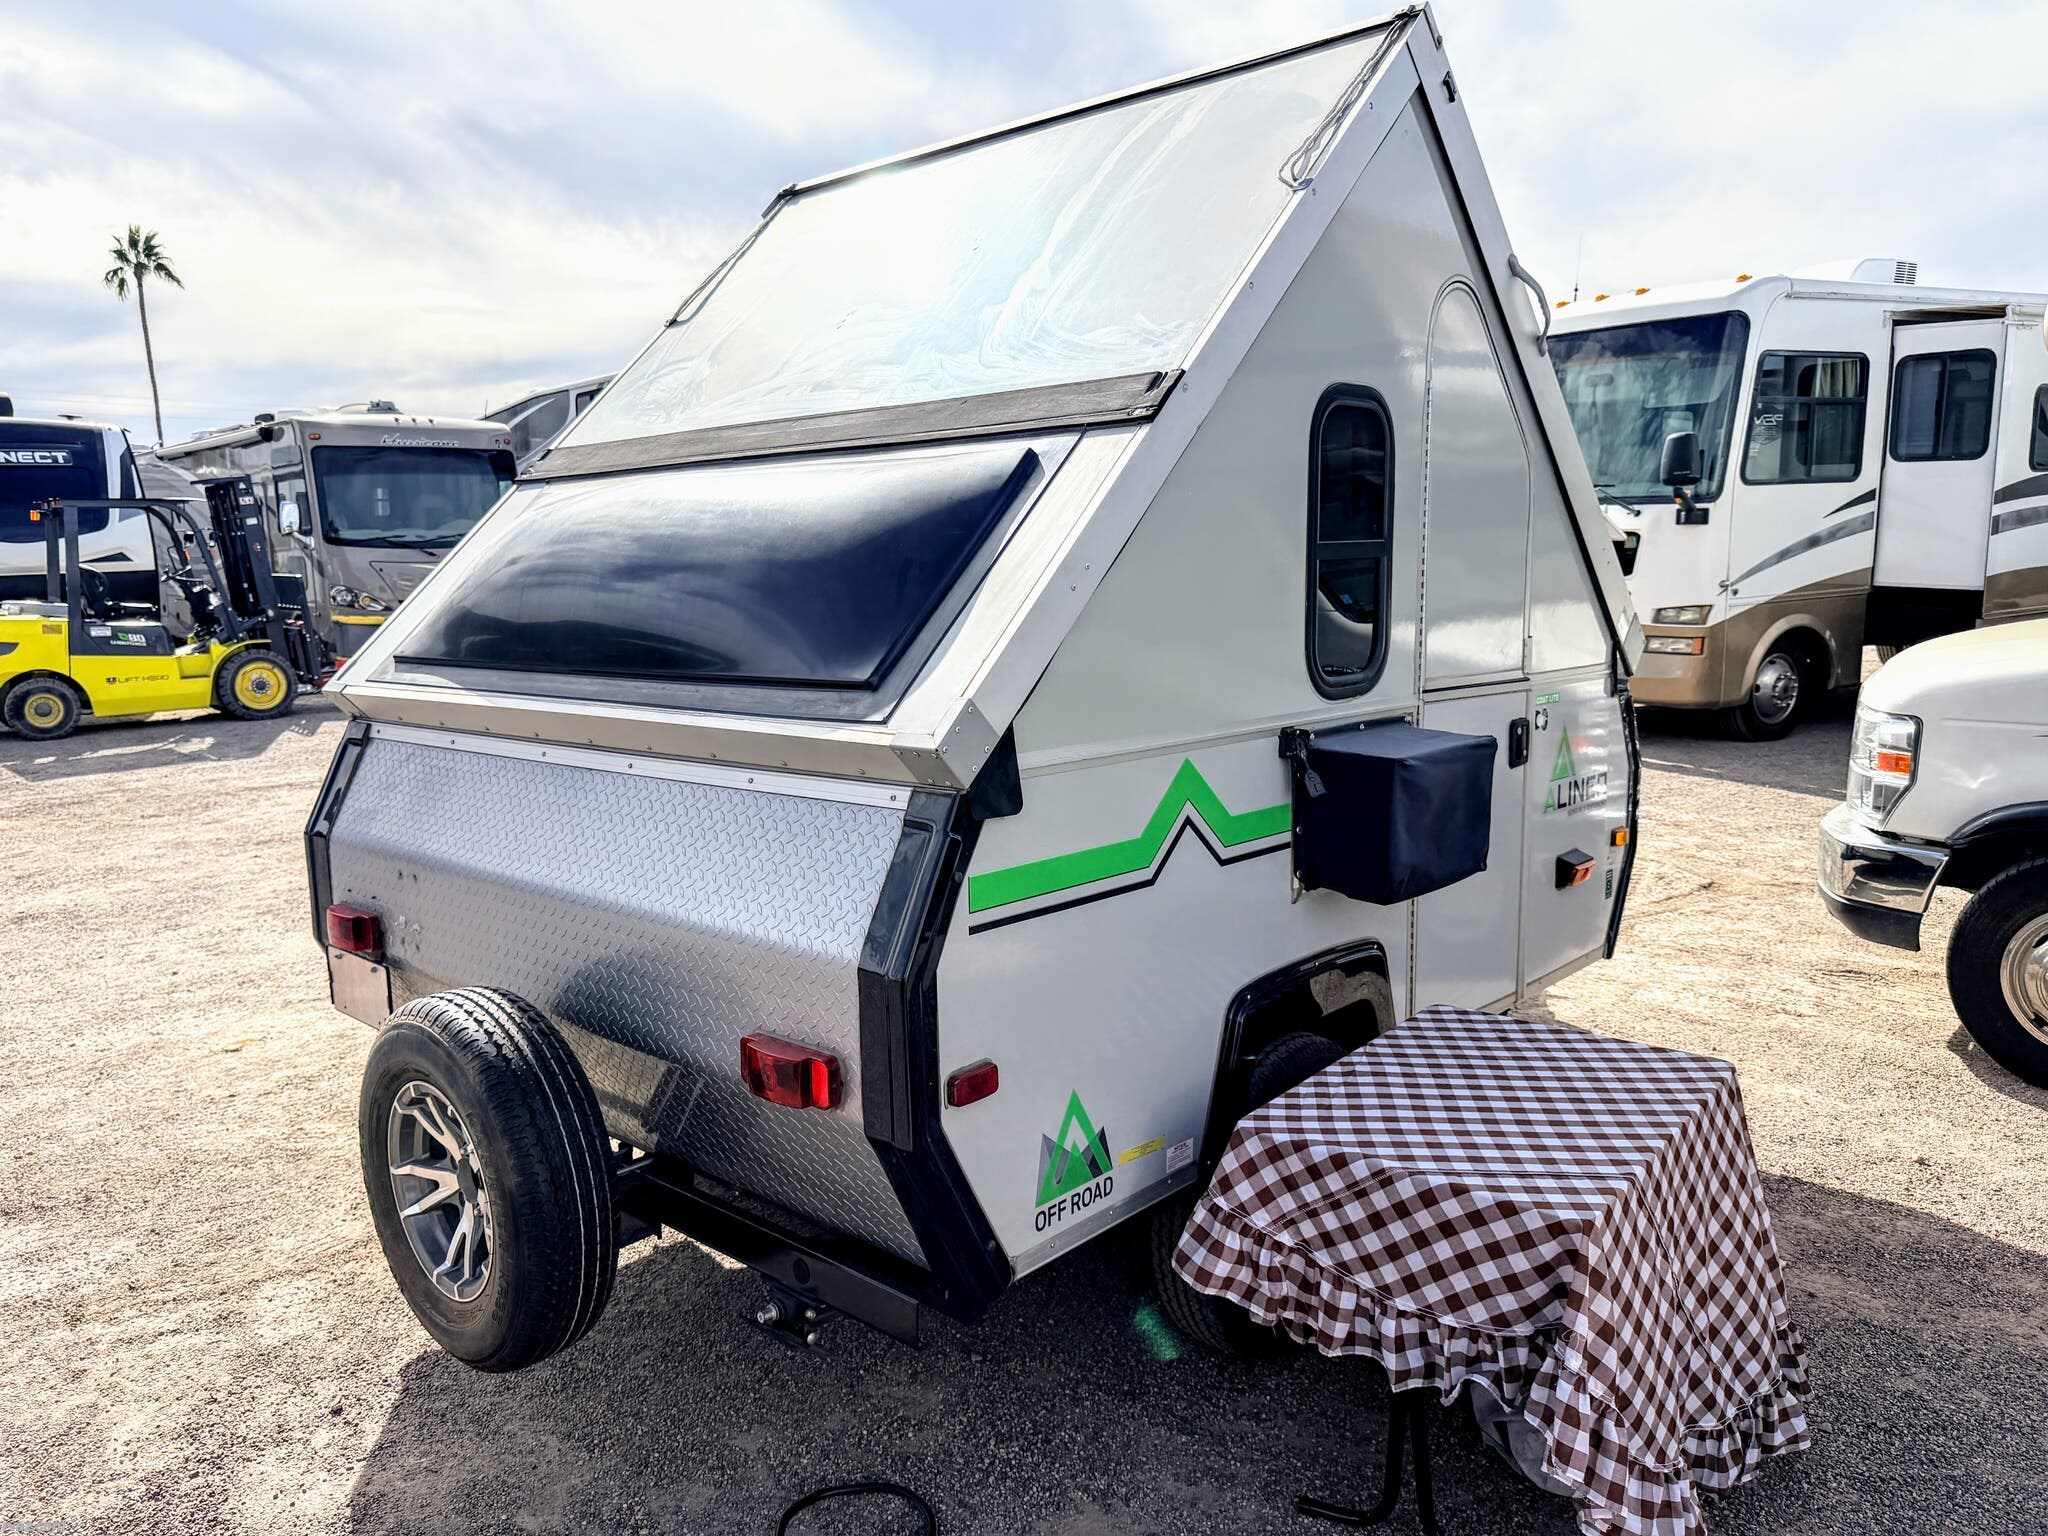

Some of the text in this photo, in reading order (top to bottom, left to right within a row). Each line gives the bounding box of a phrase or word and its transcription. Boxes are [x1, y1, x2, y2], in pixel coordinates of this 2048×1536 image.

[118, 676, 140, 684] LIFT
[1035, 1176, 1113, 1232] OFF ROAD
